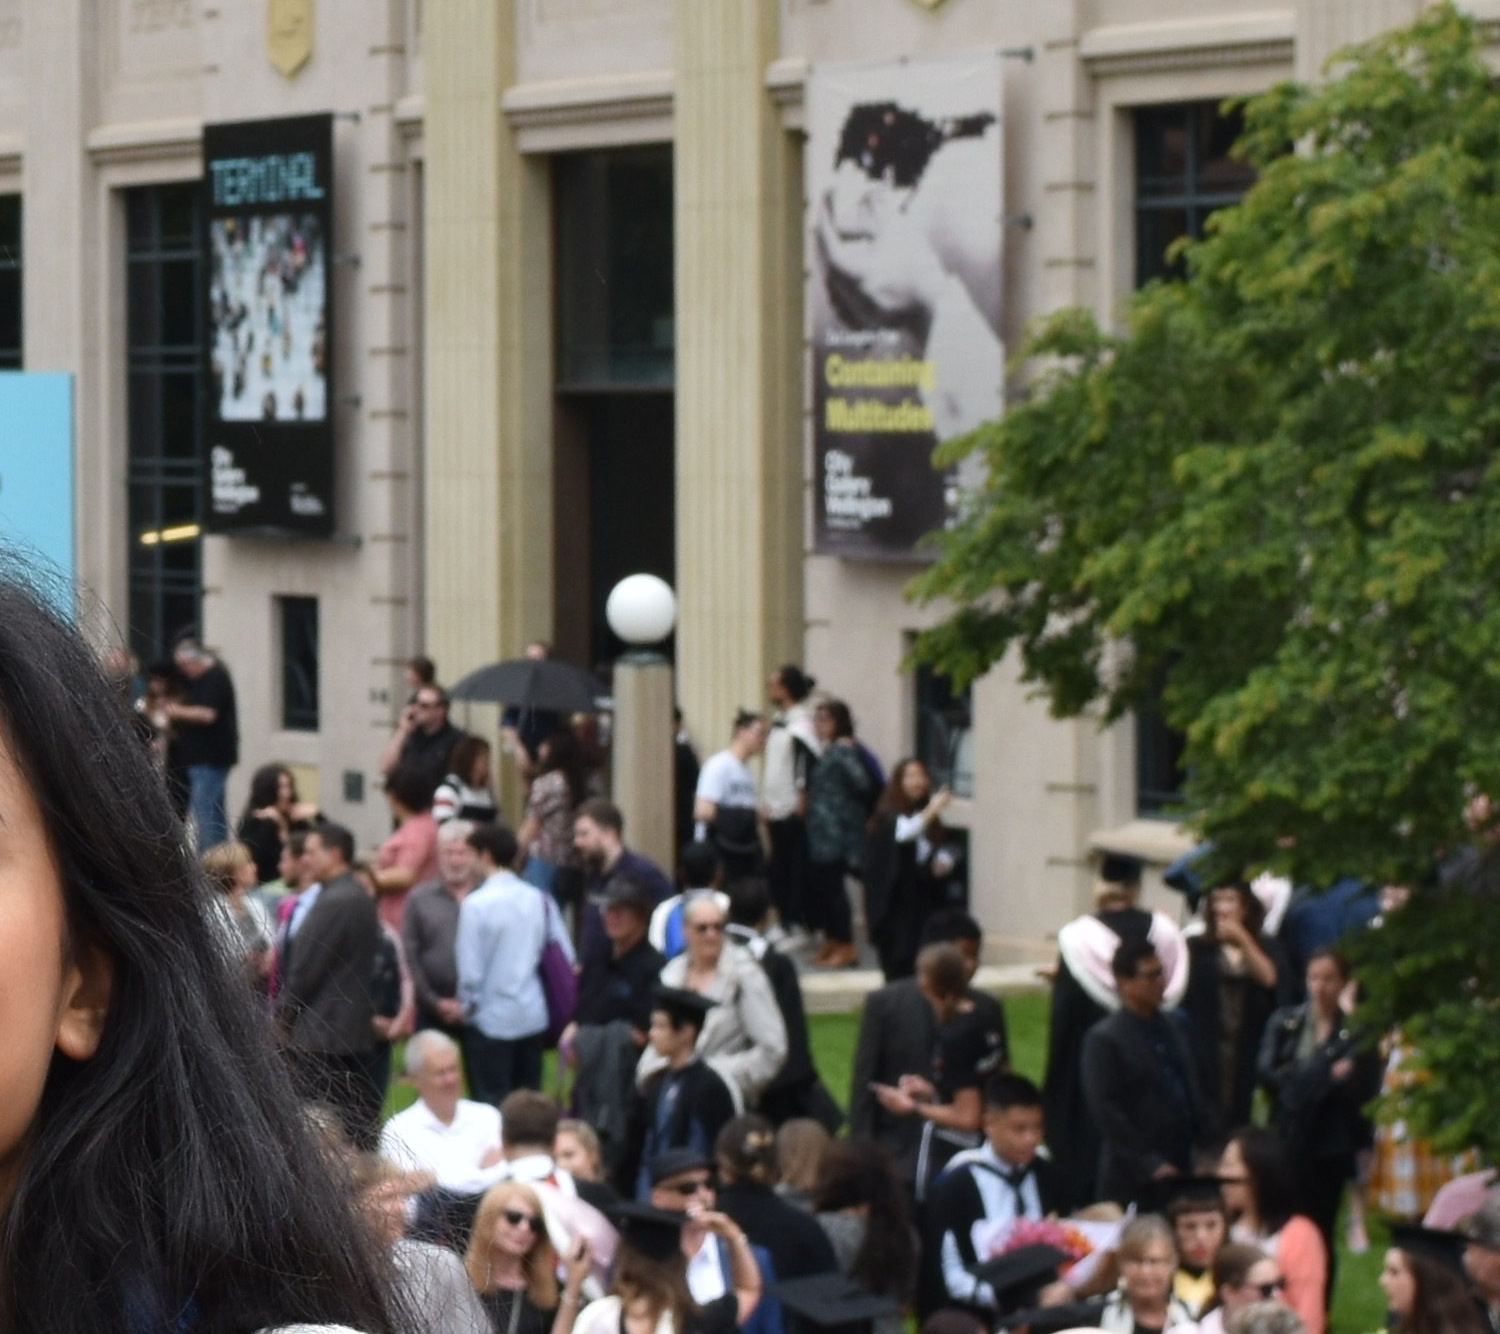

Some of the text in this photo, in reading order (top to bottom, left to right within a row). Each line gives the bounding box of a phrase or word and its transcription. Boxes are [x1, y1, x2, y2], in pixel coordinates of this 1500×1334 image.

[210, 150, 325, 206] TERMINAL
[825, 353, 935, 392] Containing
[825, 397, 935, 432] Multitudes
